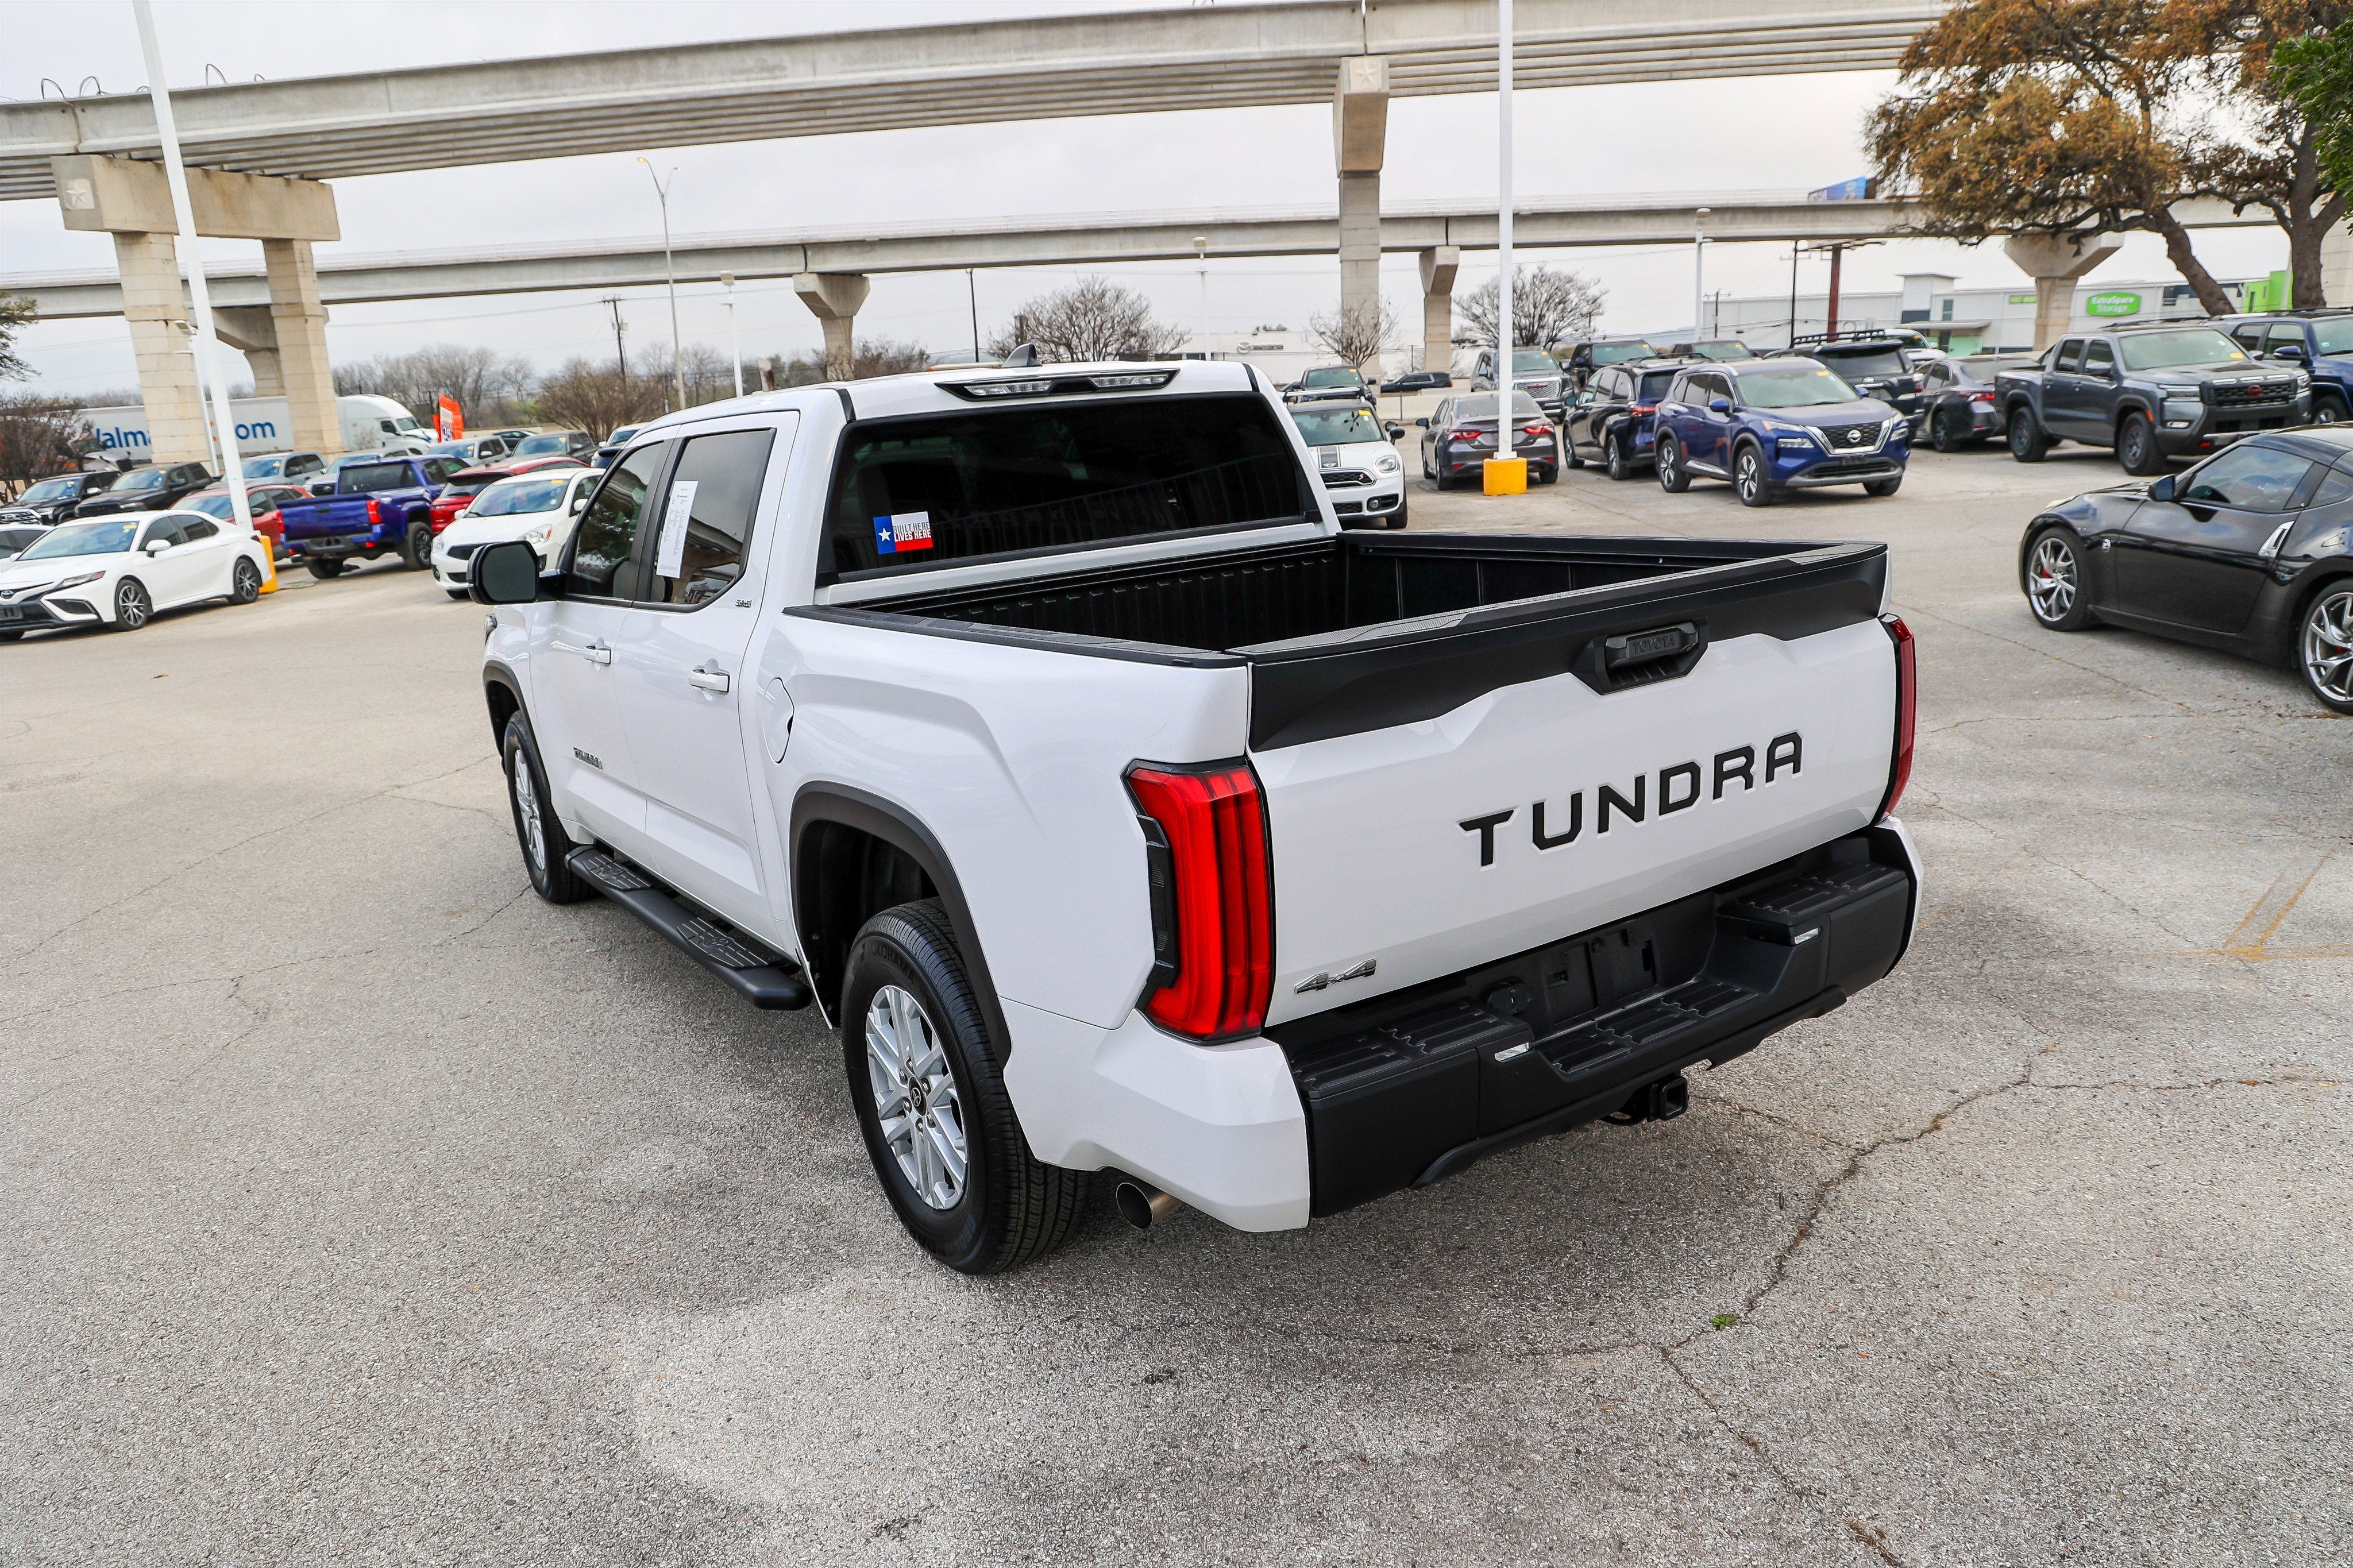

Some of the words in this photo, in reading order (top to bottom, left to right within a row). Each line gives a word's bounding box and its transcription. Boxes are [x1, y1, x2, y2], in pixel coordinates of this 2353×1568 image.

[96, 427, 151, 449] alm
[235, 422, 276, 440] om
[893, 523, 912, 534] BUILT
[912, 522, 930, 532] HERE
[894, 531, 913, 542] LIVES
[914, 529, 932, 540] HERE
[1633, 635, 1676, 654] TOYOTA
[1459, 731, 1803, 867] TUNDRA
